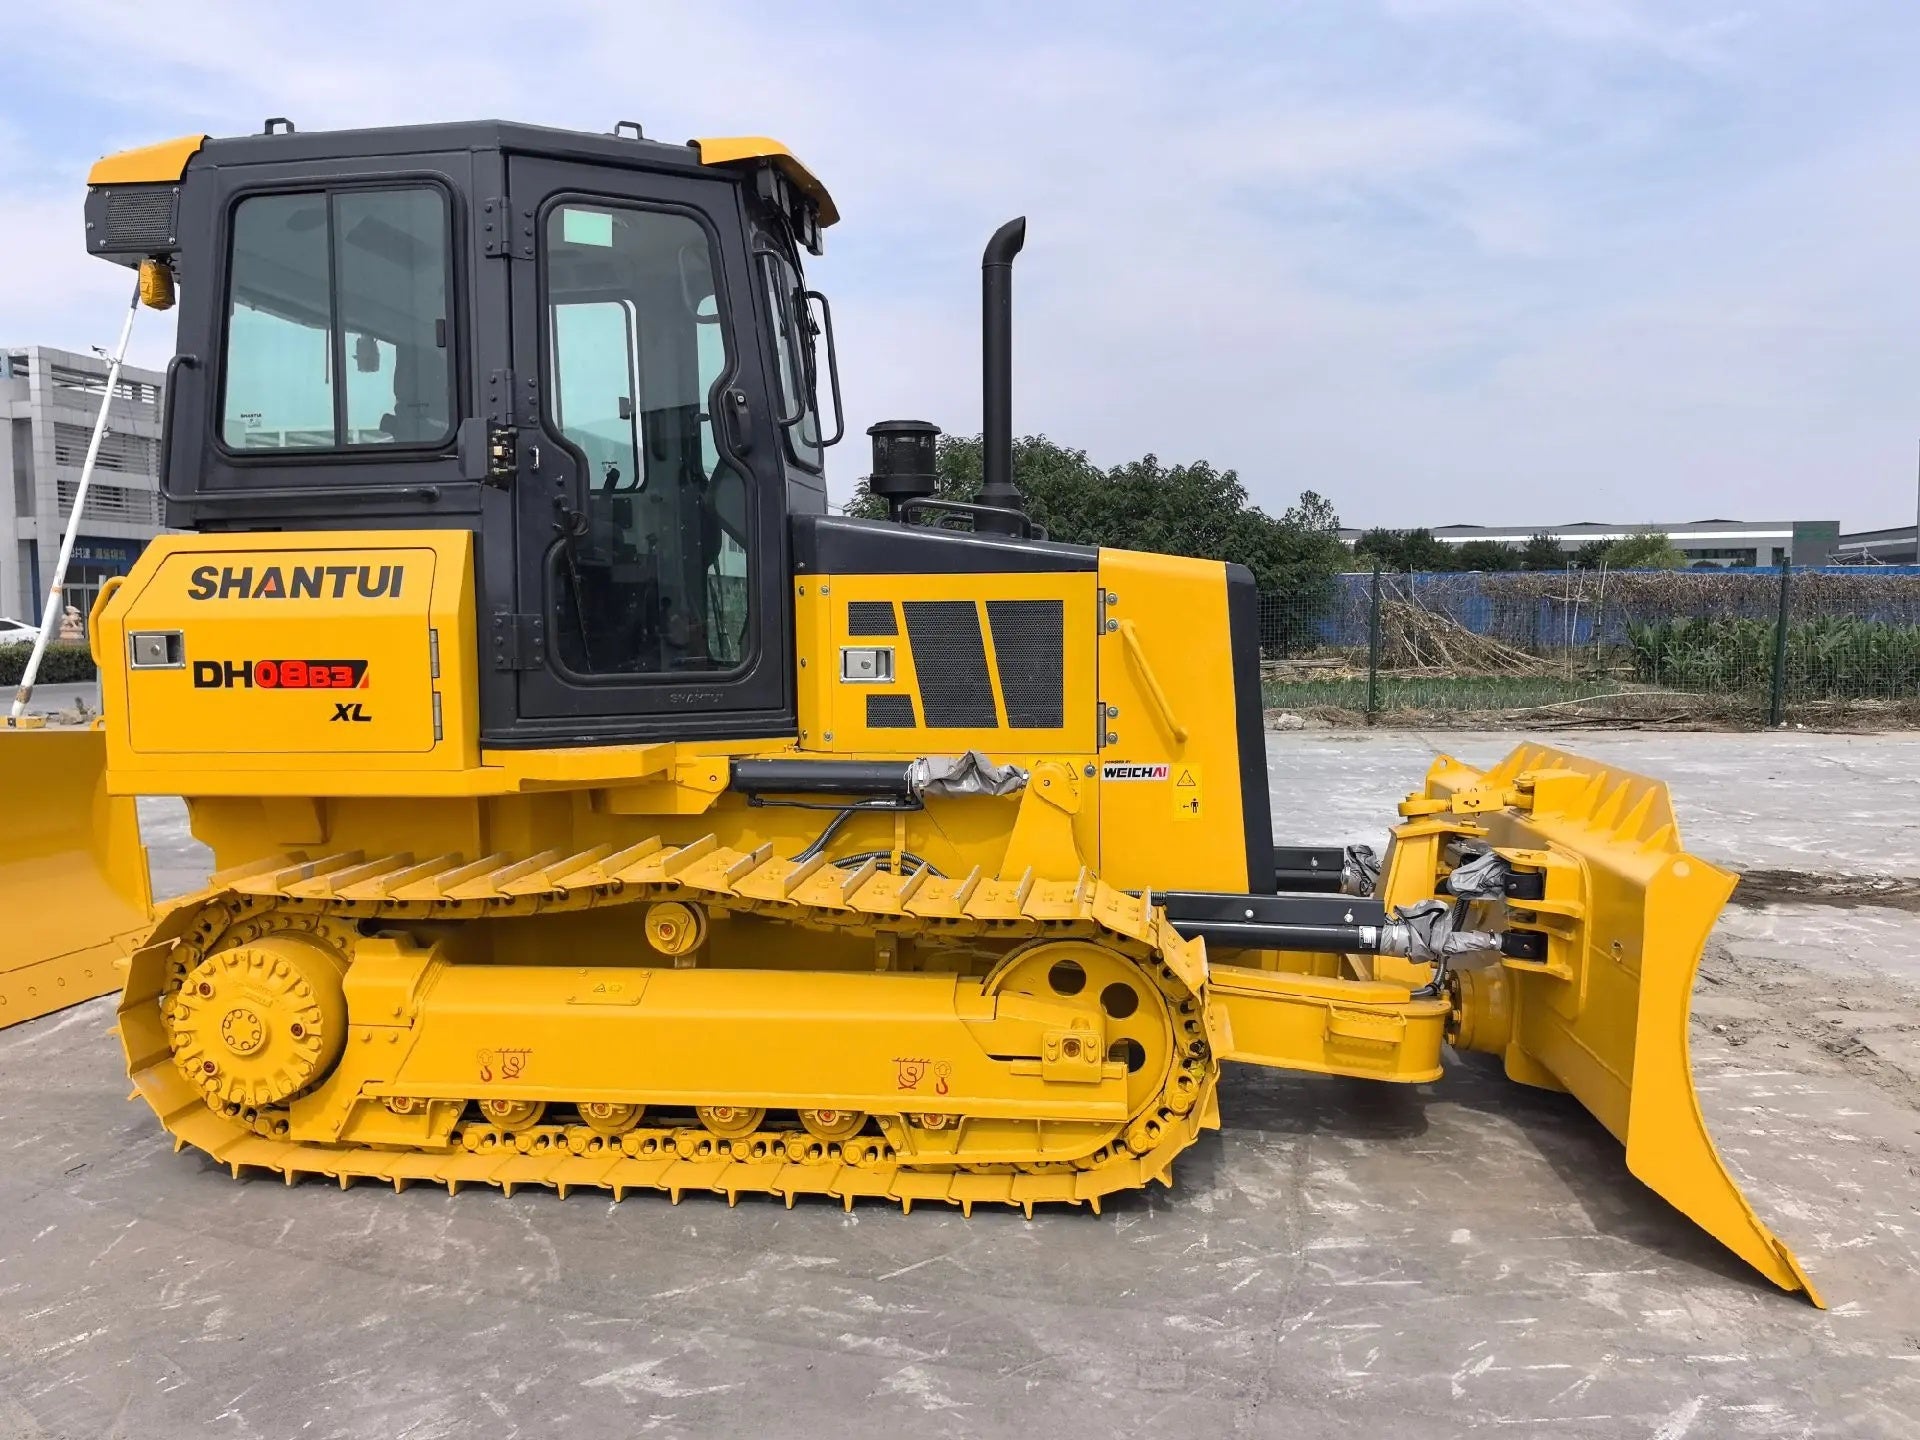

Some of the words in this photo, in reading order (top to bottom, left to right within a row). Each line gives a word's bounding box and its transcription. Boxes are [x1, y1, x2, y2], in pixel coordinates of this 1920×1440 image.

[188, 565, 404, 600] SHANTUI
[193, 660, 356, 689] DH08B3
[330, 703, 373, 722] XL
[1104, 766, 1168, 778] WEICHAI
